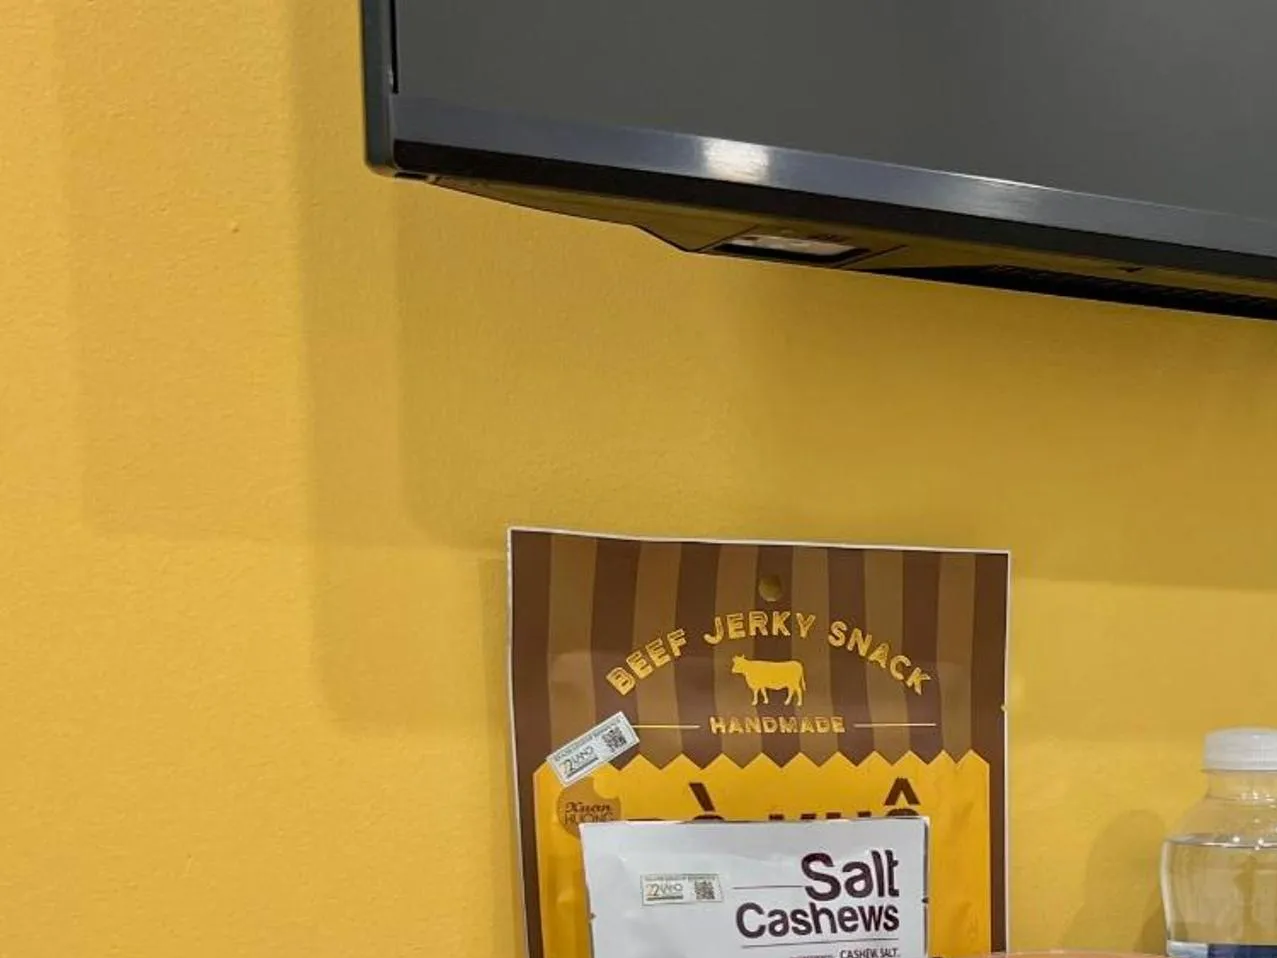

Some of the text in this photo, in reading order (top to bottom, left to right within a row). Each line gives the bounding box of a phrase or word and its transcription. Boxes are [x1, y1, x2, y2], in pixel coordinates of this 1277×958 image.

[605, 610, 932, 696] BEEF JERKY SNACK
[709, 716, 846, 734] HANDMADE
[801, 850, 900, 901] Salt
[736, 902, 900, 938] Cashews
